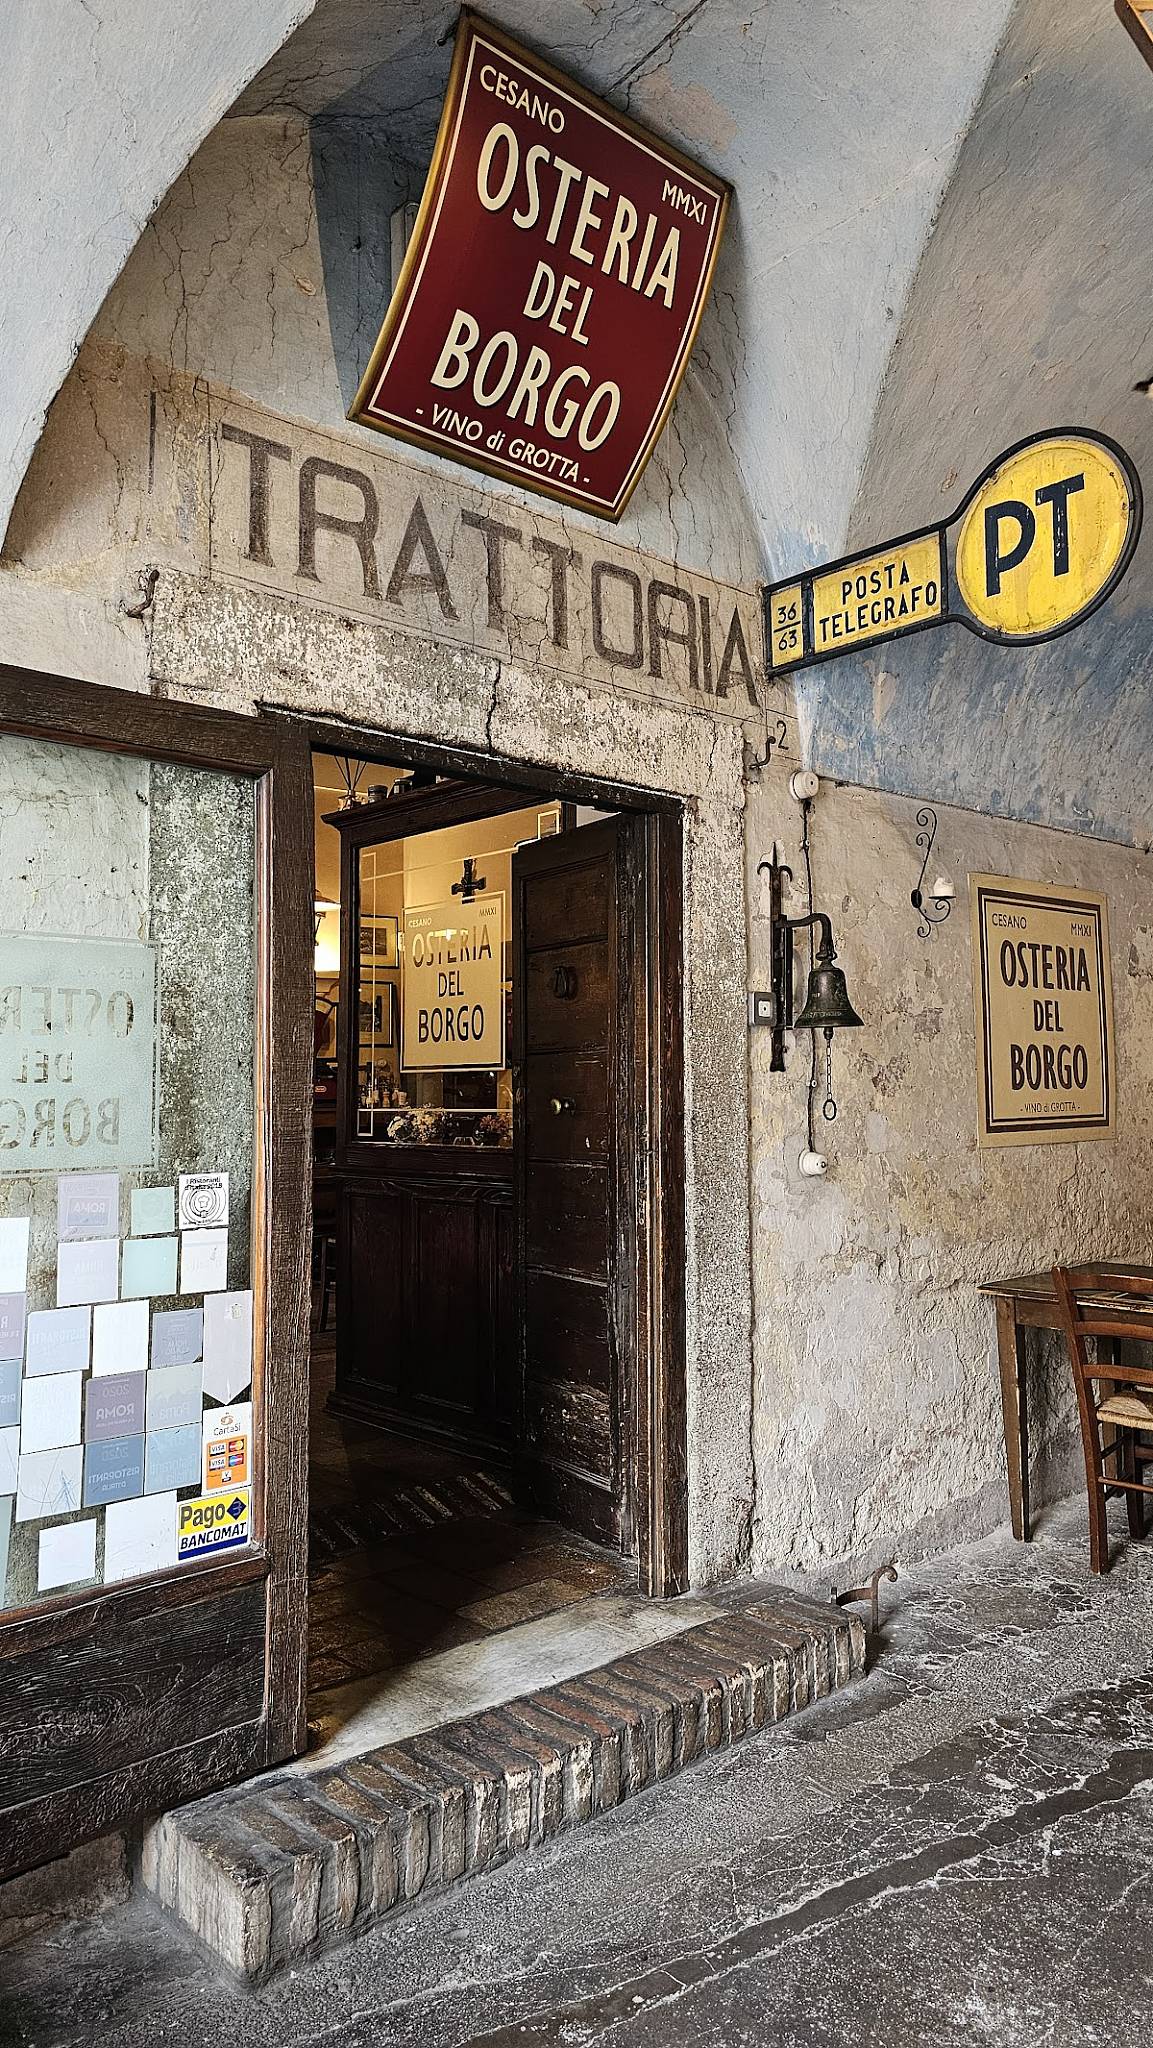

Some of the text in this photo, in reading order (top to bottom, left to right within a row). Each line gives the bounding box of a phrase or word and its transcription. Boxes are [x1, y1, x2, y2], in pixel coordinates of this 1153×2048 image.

[479, 65, 565, 134] CESANO
[477, 122, 680, 309] OSTERIA
[661, 179, 708, 226] MMXI
[522, 260, 594, 345] DEL
[430, 308, 621, 451] BORGO
[431, 403, 483, 441] VINO
[486, 430, 505, 452] di
[508, 438, 581, 483] GROTTA
[984, 473, 1085, 598] PT
[221, 423, 759, 708] TRATTORIA
[841, 560, 910, 606] POSTA
[777, 600, 797, 626] 36
[819, 581, 938, 643] TELEGRAFO
[777, 628, 799, 652] 63
[408, 917, 432, 928] CESANO
[991, 913, 1027, 930] CESANO
[1070, 922, 1092, 937] MMXI
[412, 924, 492, 968] OSTERIA
[1000, 939, 1091, 992] OSTERIA
[438, 970, 464, 998] DEL
[418, 1004, 484, 1044] BORGO
[1033, 999, 1064, 1032] DEL
[1010, 1044, 1088, 1091] BORGO
[1024, 1102, 1042, 1113] VINO
[1050, 1100, 1077, 1112] GROTTA
[210, 1444, 226, 1454] VISA
[210, 1459, 226, 1468] VISA
[180, 1504, 226, 1530] Pago
[180, 1522, 247, 1550] BANCOMAT
